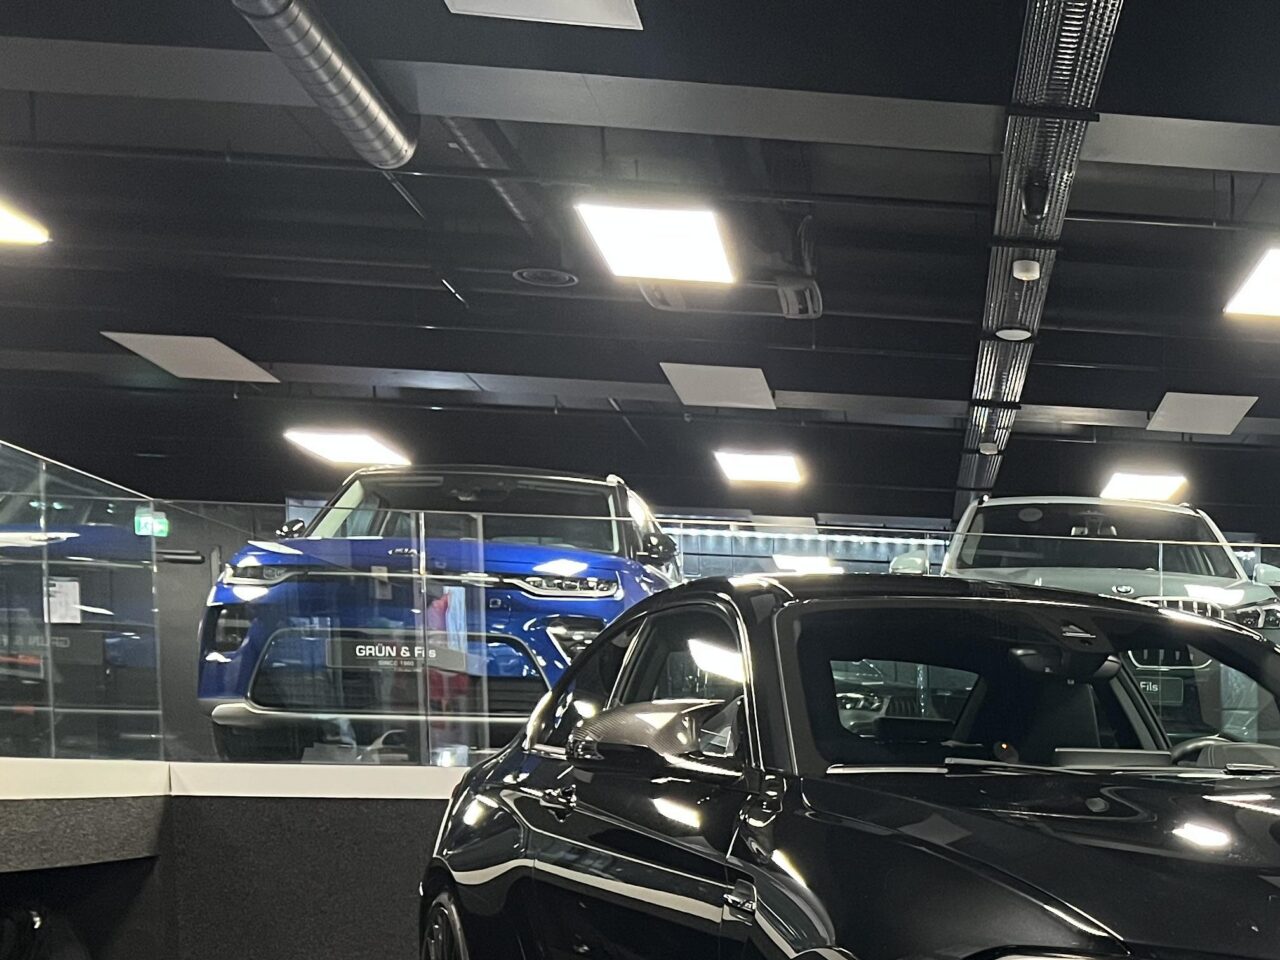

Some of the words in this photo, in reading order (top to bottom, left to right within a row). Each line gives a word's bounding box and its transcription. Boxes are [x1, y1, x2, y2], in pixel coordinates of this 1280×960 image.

[355, 643, 397, 657] GRÜN
[400, 646, 411, 658] &
[414, 646, 437, 658] Fis
[1139, 681, 1159, 692] Fils
